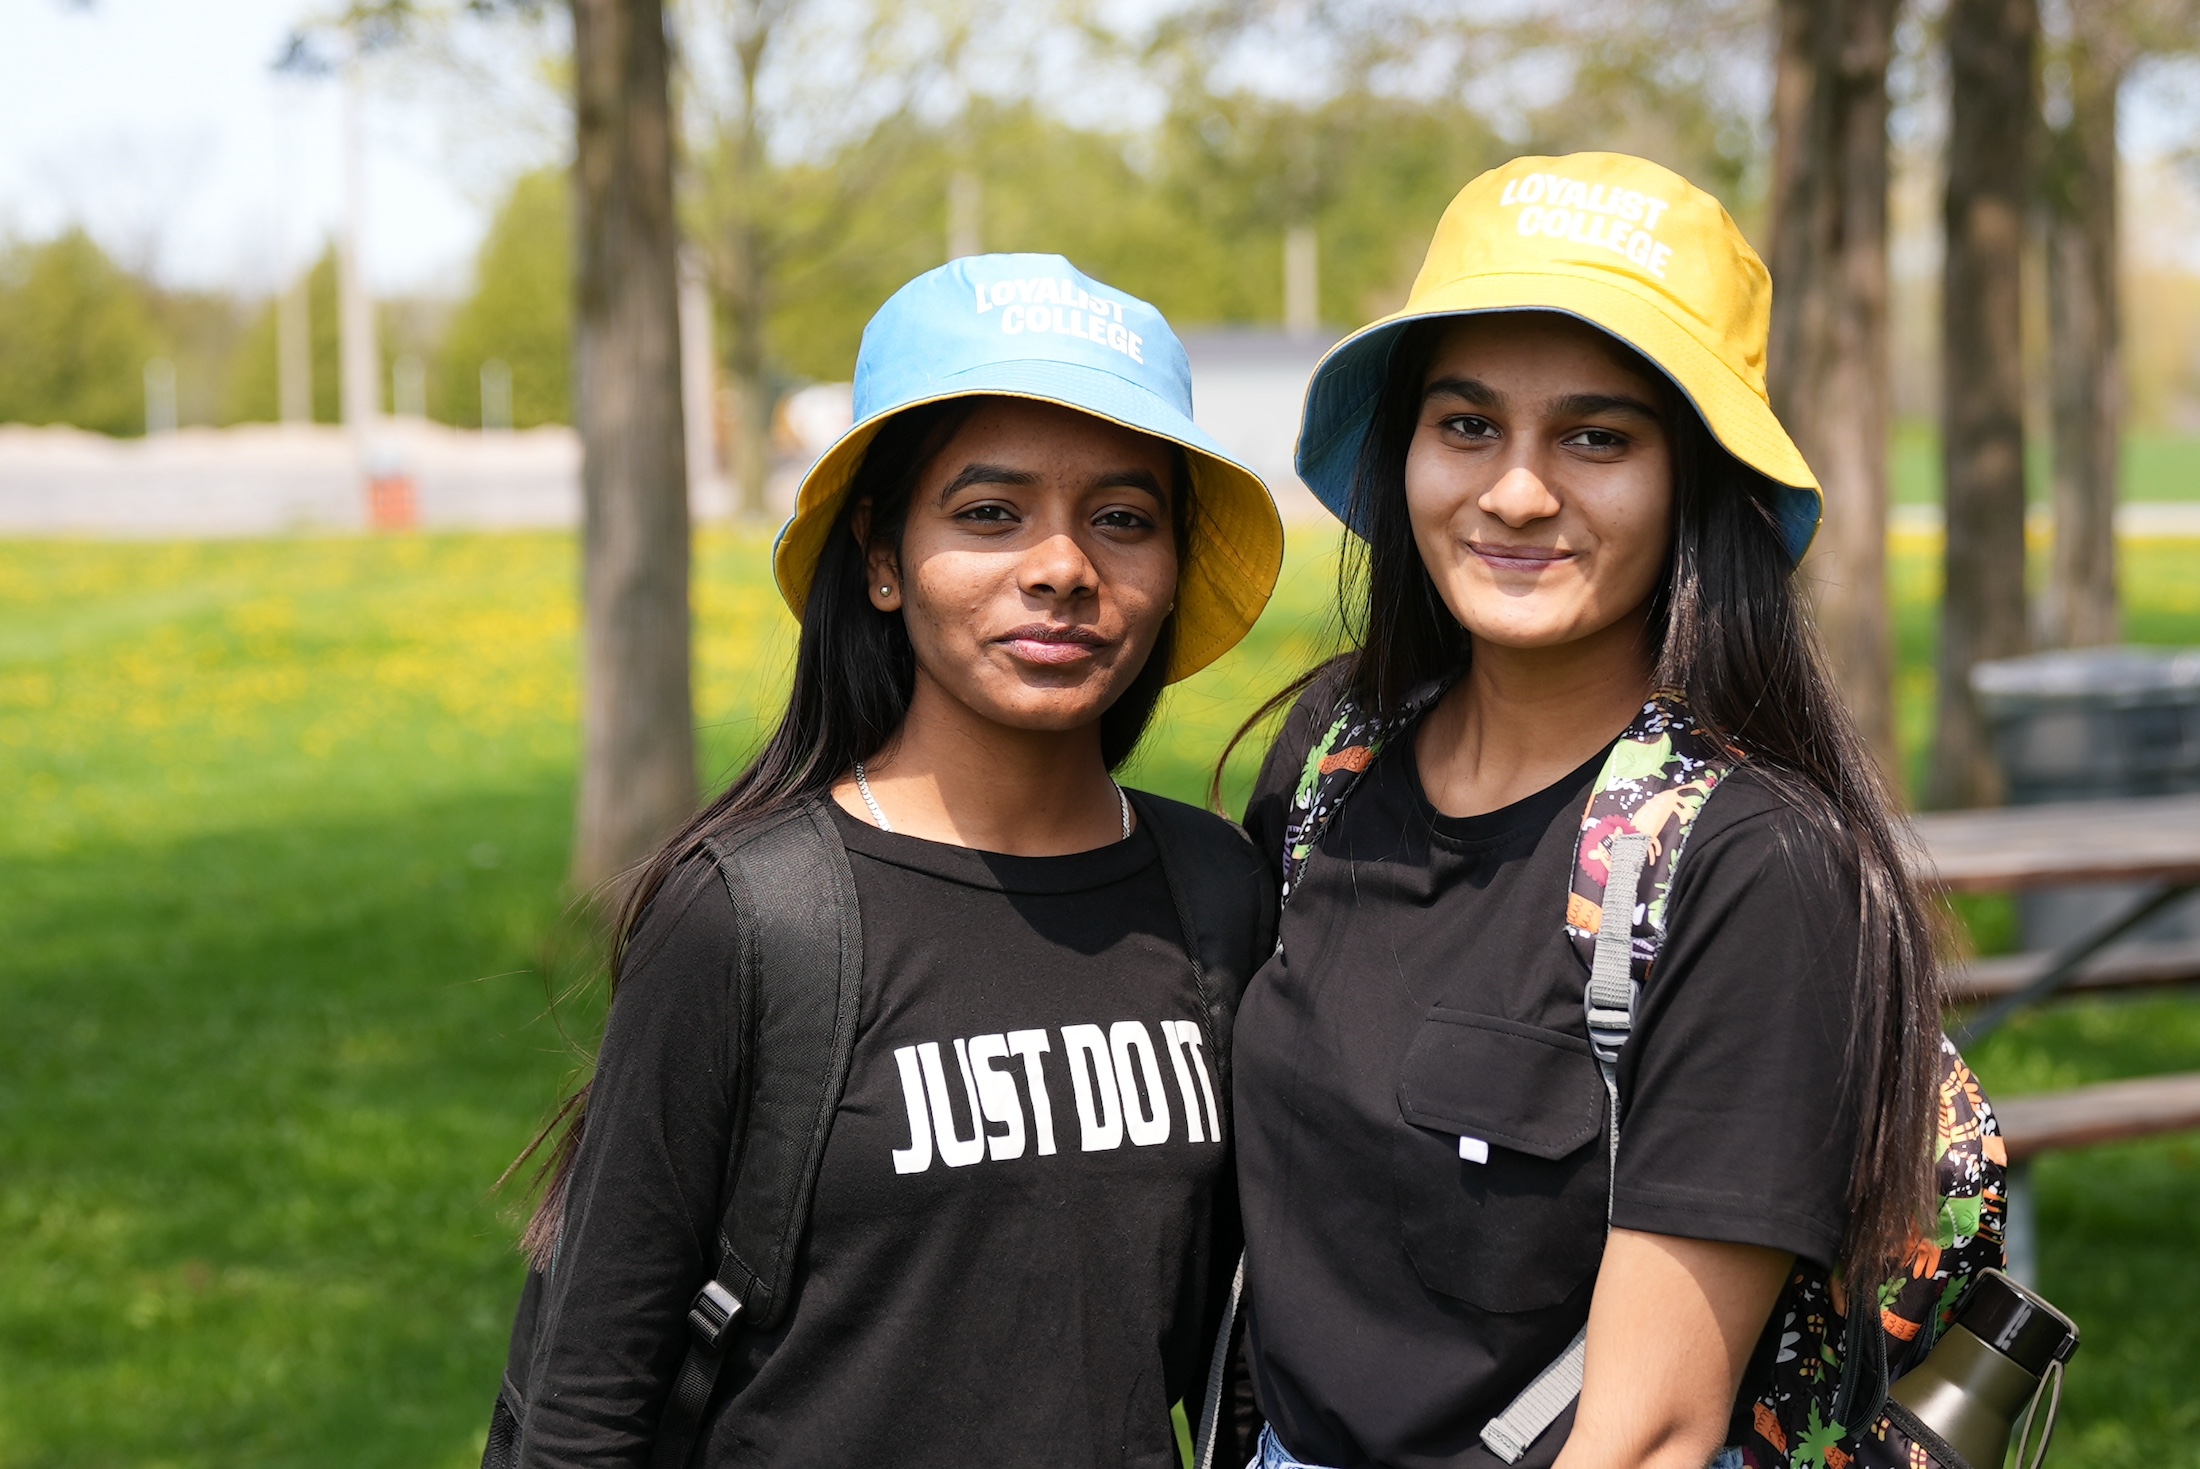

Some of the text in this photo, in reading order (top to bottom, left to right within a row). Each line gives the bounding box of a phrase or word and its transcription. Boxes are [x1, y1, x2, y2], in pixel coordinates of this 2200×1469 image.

[1500, 173, 1669, 230] LOYALIST
[1517, 206, 1673, 279] COLLEGE
[974, 277, 1125, 323] LOYALIST
[1001, 305, 1144, 364] COLLEGE
[892, 1020, 1221, 1174] JUST DO IT
